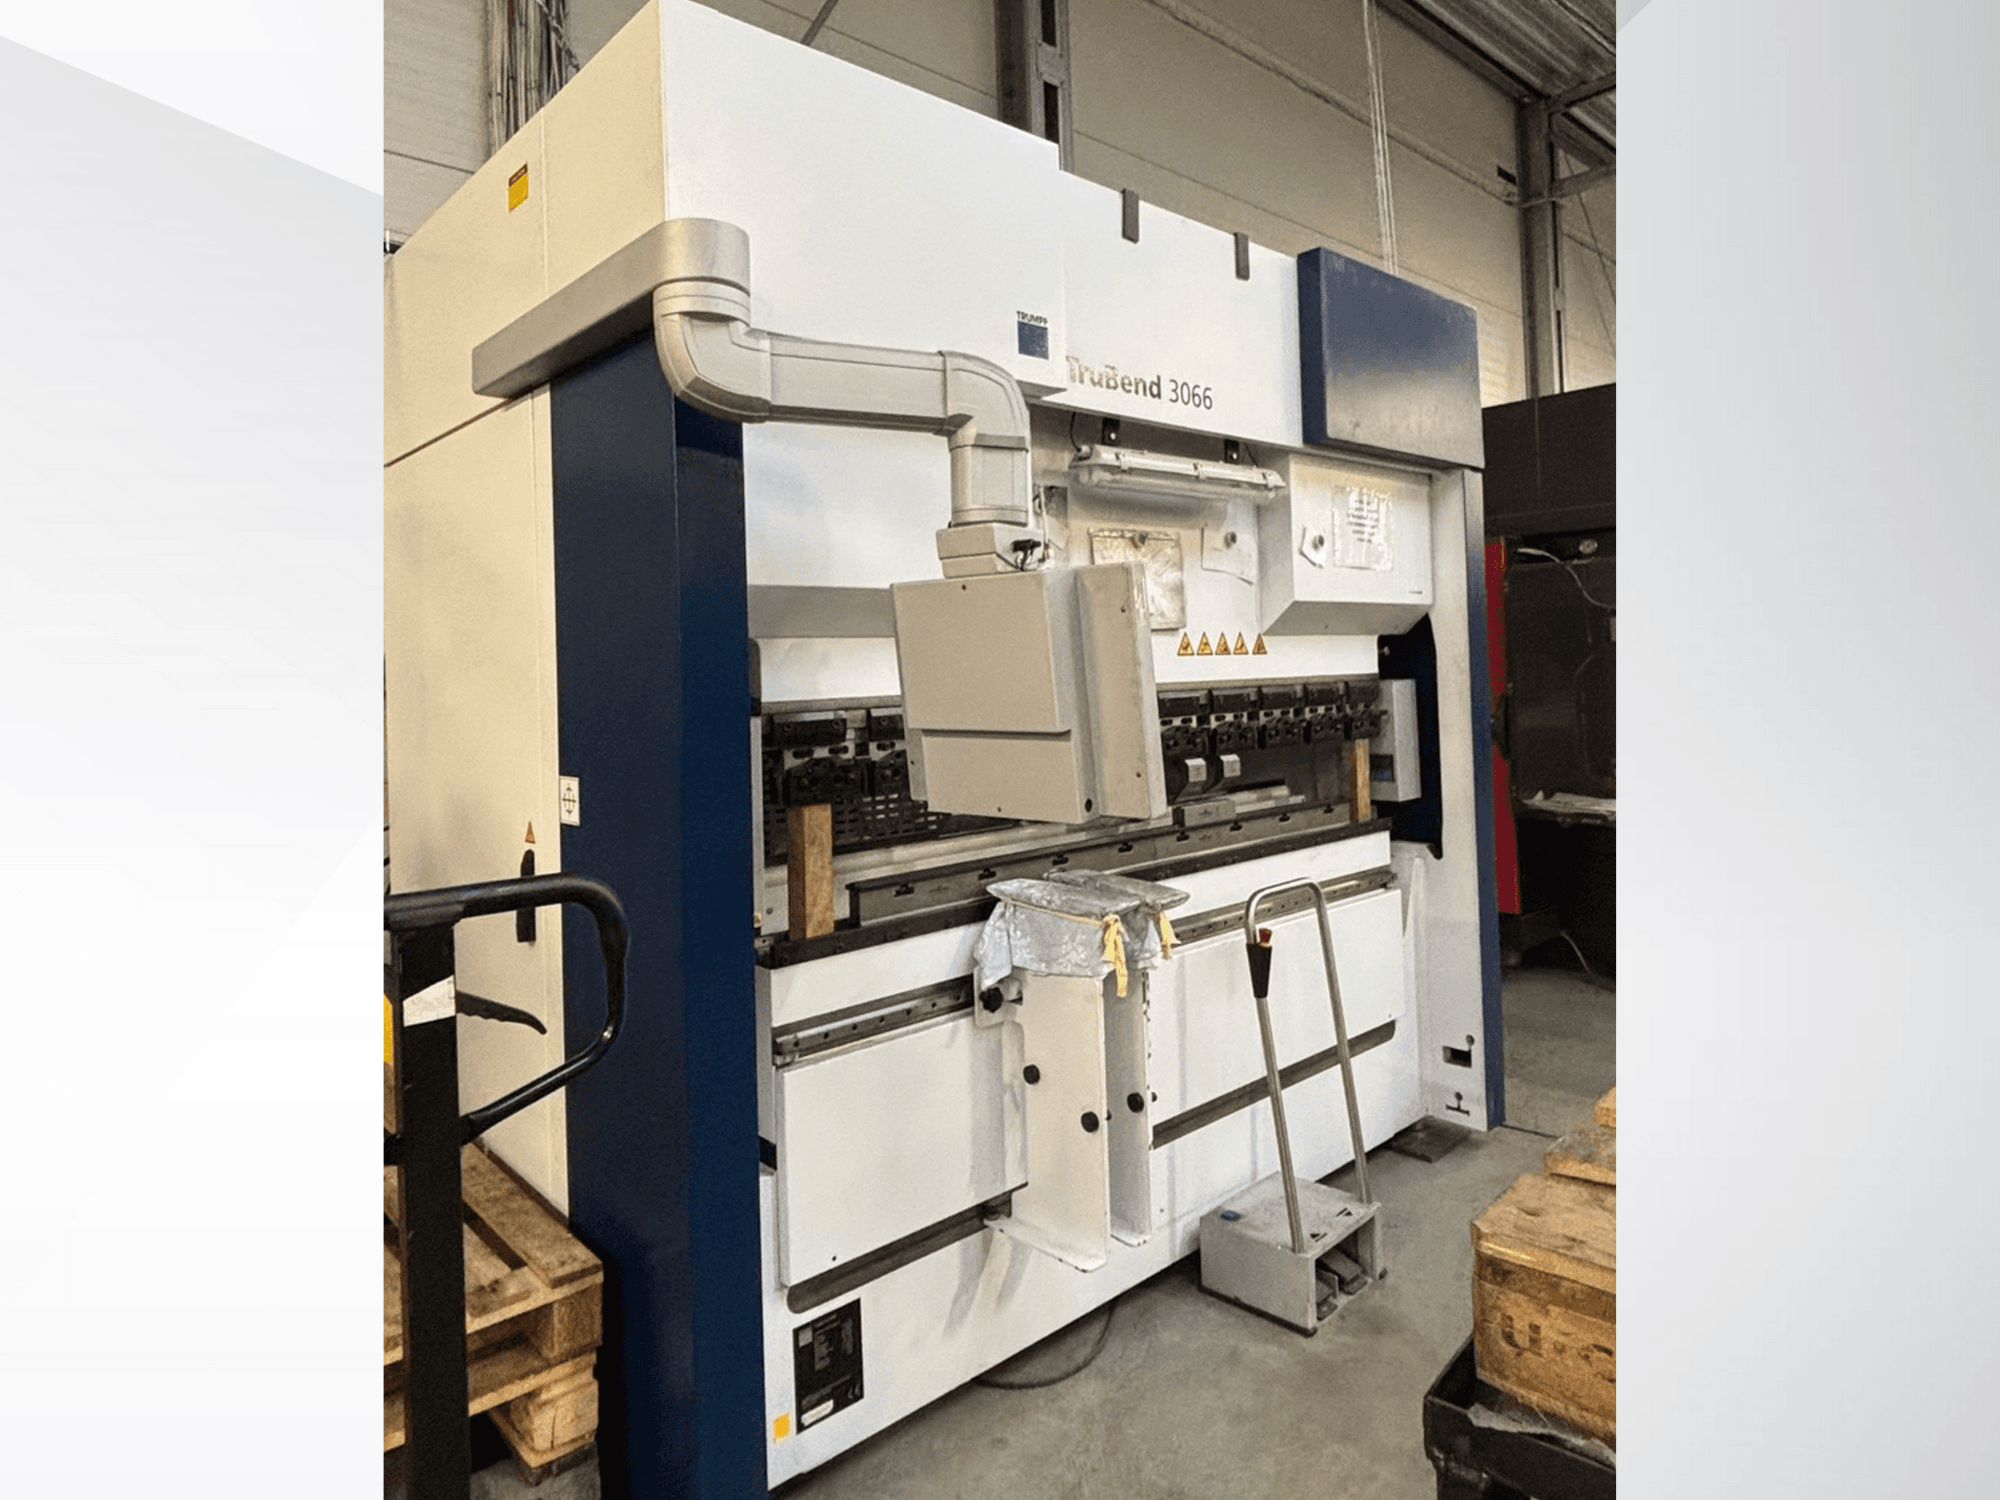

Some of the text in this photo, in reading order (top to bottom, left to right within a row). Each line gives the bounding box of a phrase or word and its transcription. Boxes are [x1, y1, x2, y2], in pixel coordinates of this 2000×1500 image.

[1016, 310, 1048, 325] TRUMPF
[1065, 355, 1213, 410] TruBend 3066
